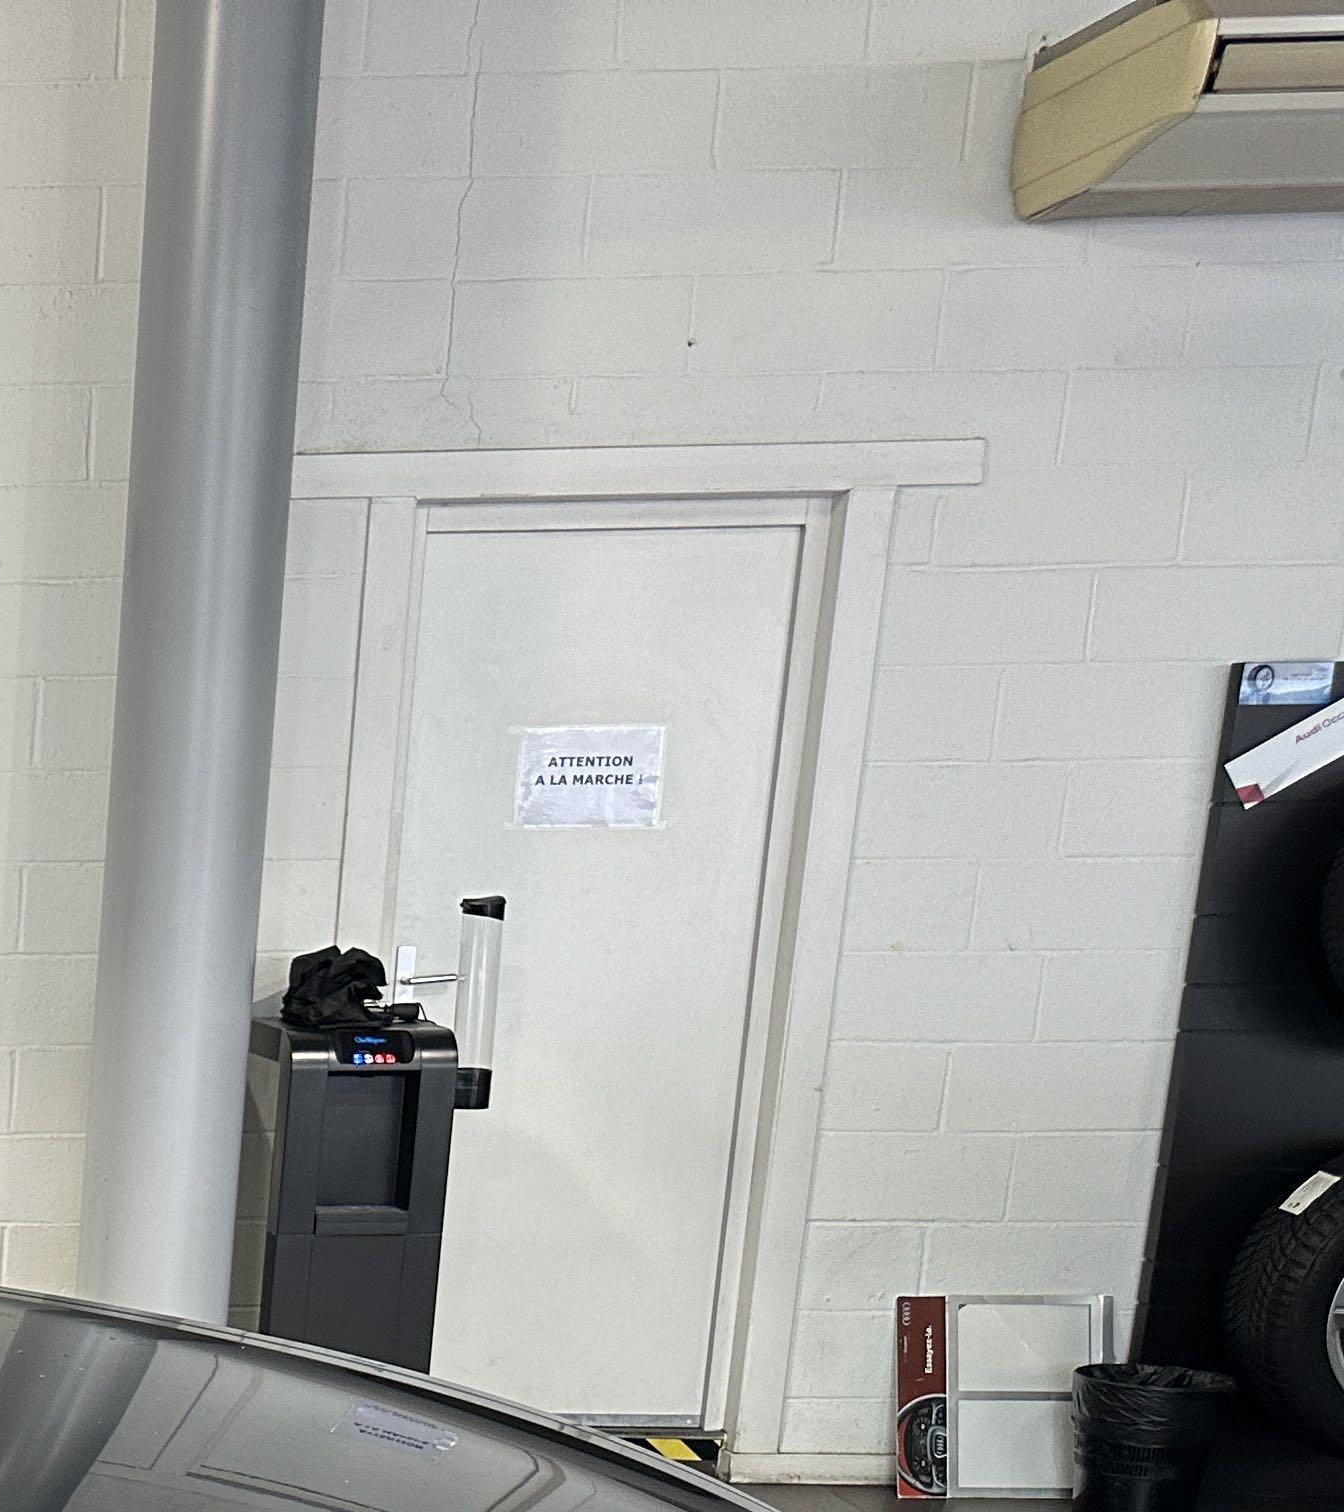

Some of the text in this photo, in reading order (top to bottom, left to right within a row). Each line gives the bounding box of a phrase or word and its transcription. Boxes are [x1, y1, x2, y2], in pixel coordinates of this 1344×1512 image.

[547, 756, 634, 768] ATTENTION
[534, 775, 546, 786] A
[549, 775, 568, 786] LA
[572, 774, 634, 786] MARCHE
